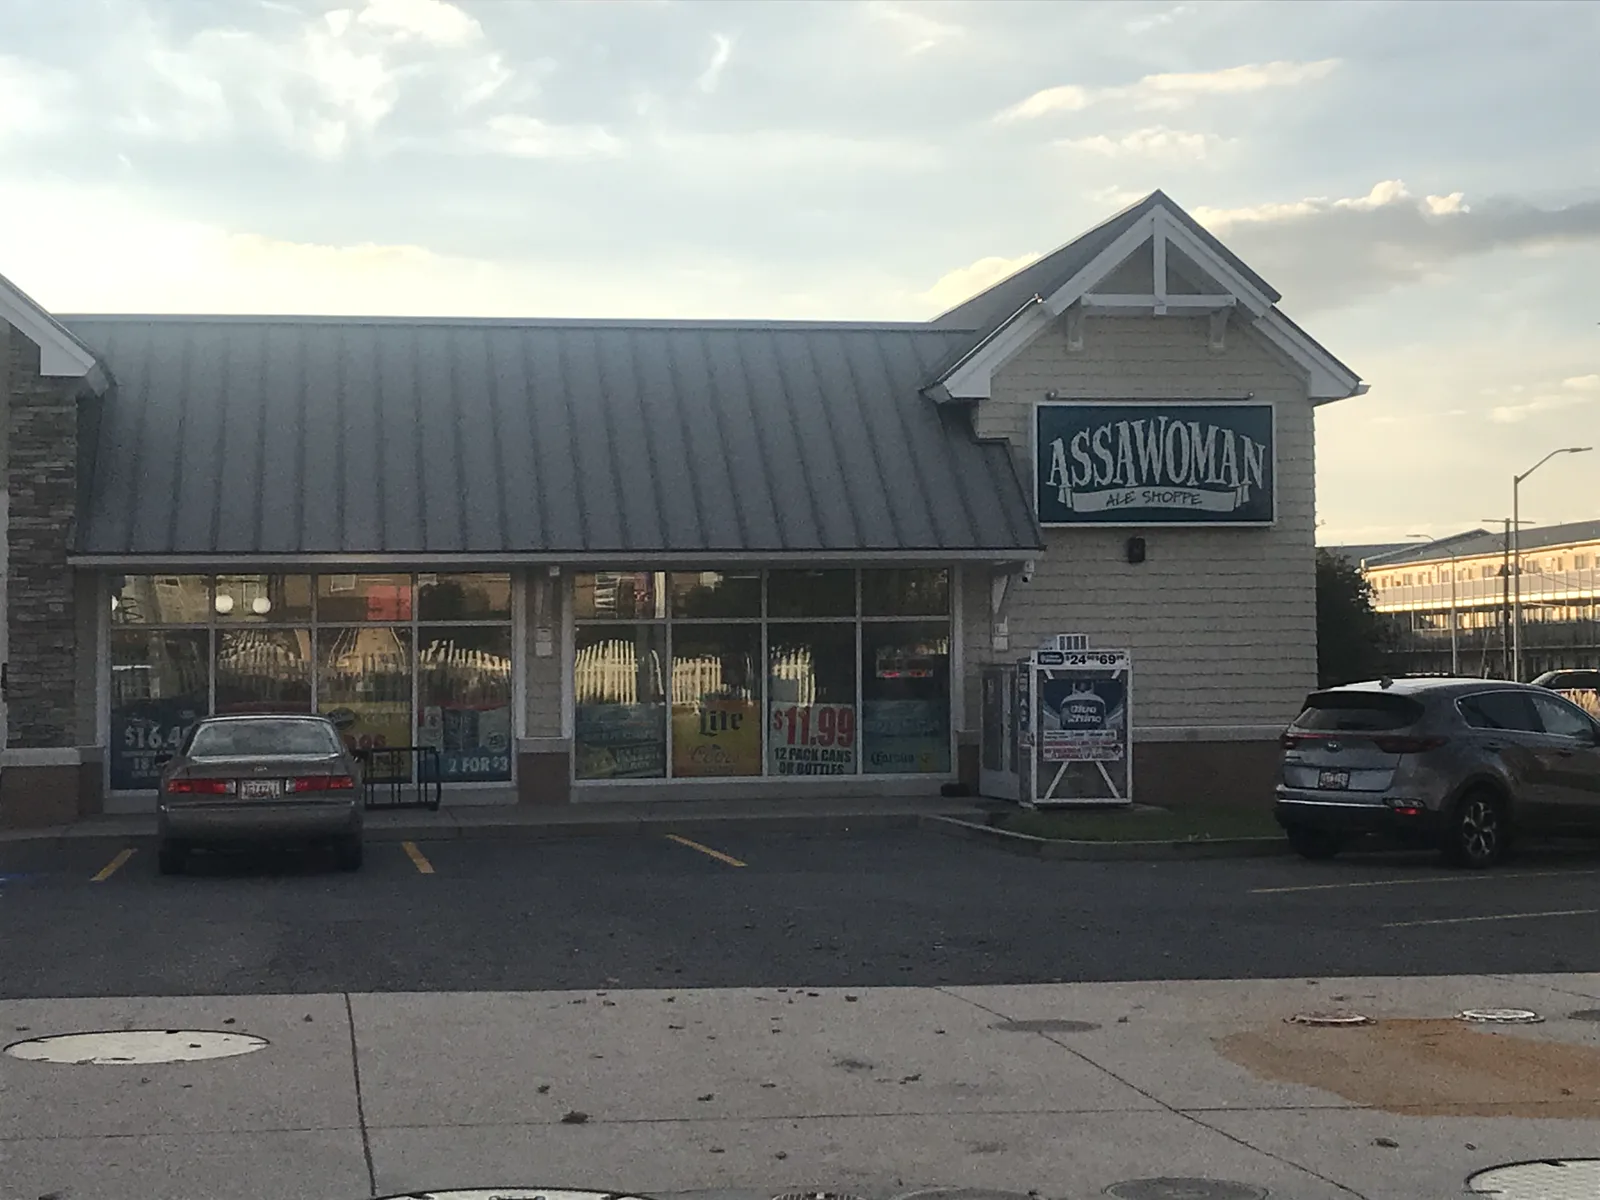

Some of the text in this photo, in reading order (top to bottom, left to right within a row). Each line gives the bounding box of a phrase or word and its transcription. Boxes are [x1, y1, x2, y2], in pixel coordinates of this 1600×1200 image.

[1046, 416, 1266, 489] ASSAWOMAN
[1106, 490, 1203, 506] ALE SHOPPE
[699, 705, 743, 737] Lite
[773, 706, 855, 747] $11.99
[775, 748, 852, 763] 12 PACK CANS
[462, 757, 490, 772] FOR
[778, 761, 845, 776] OR BOTTLES
